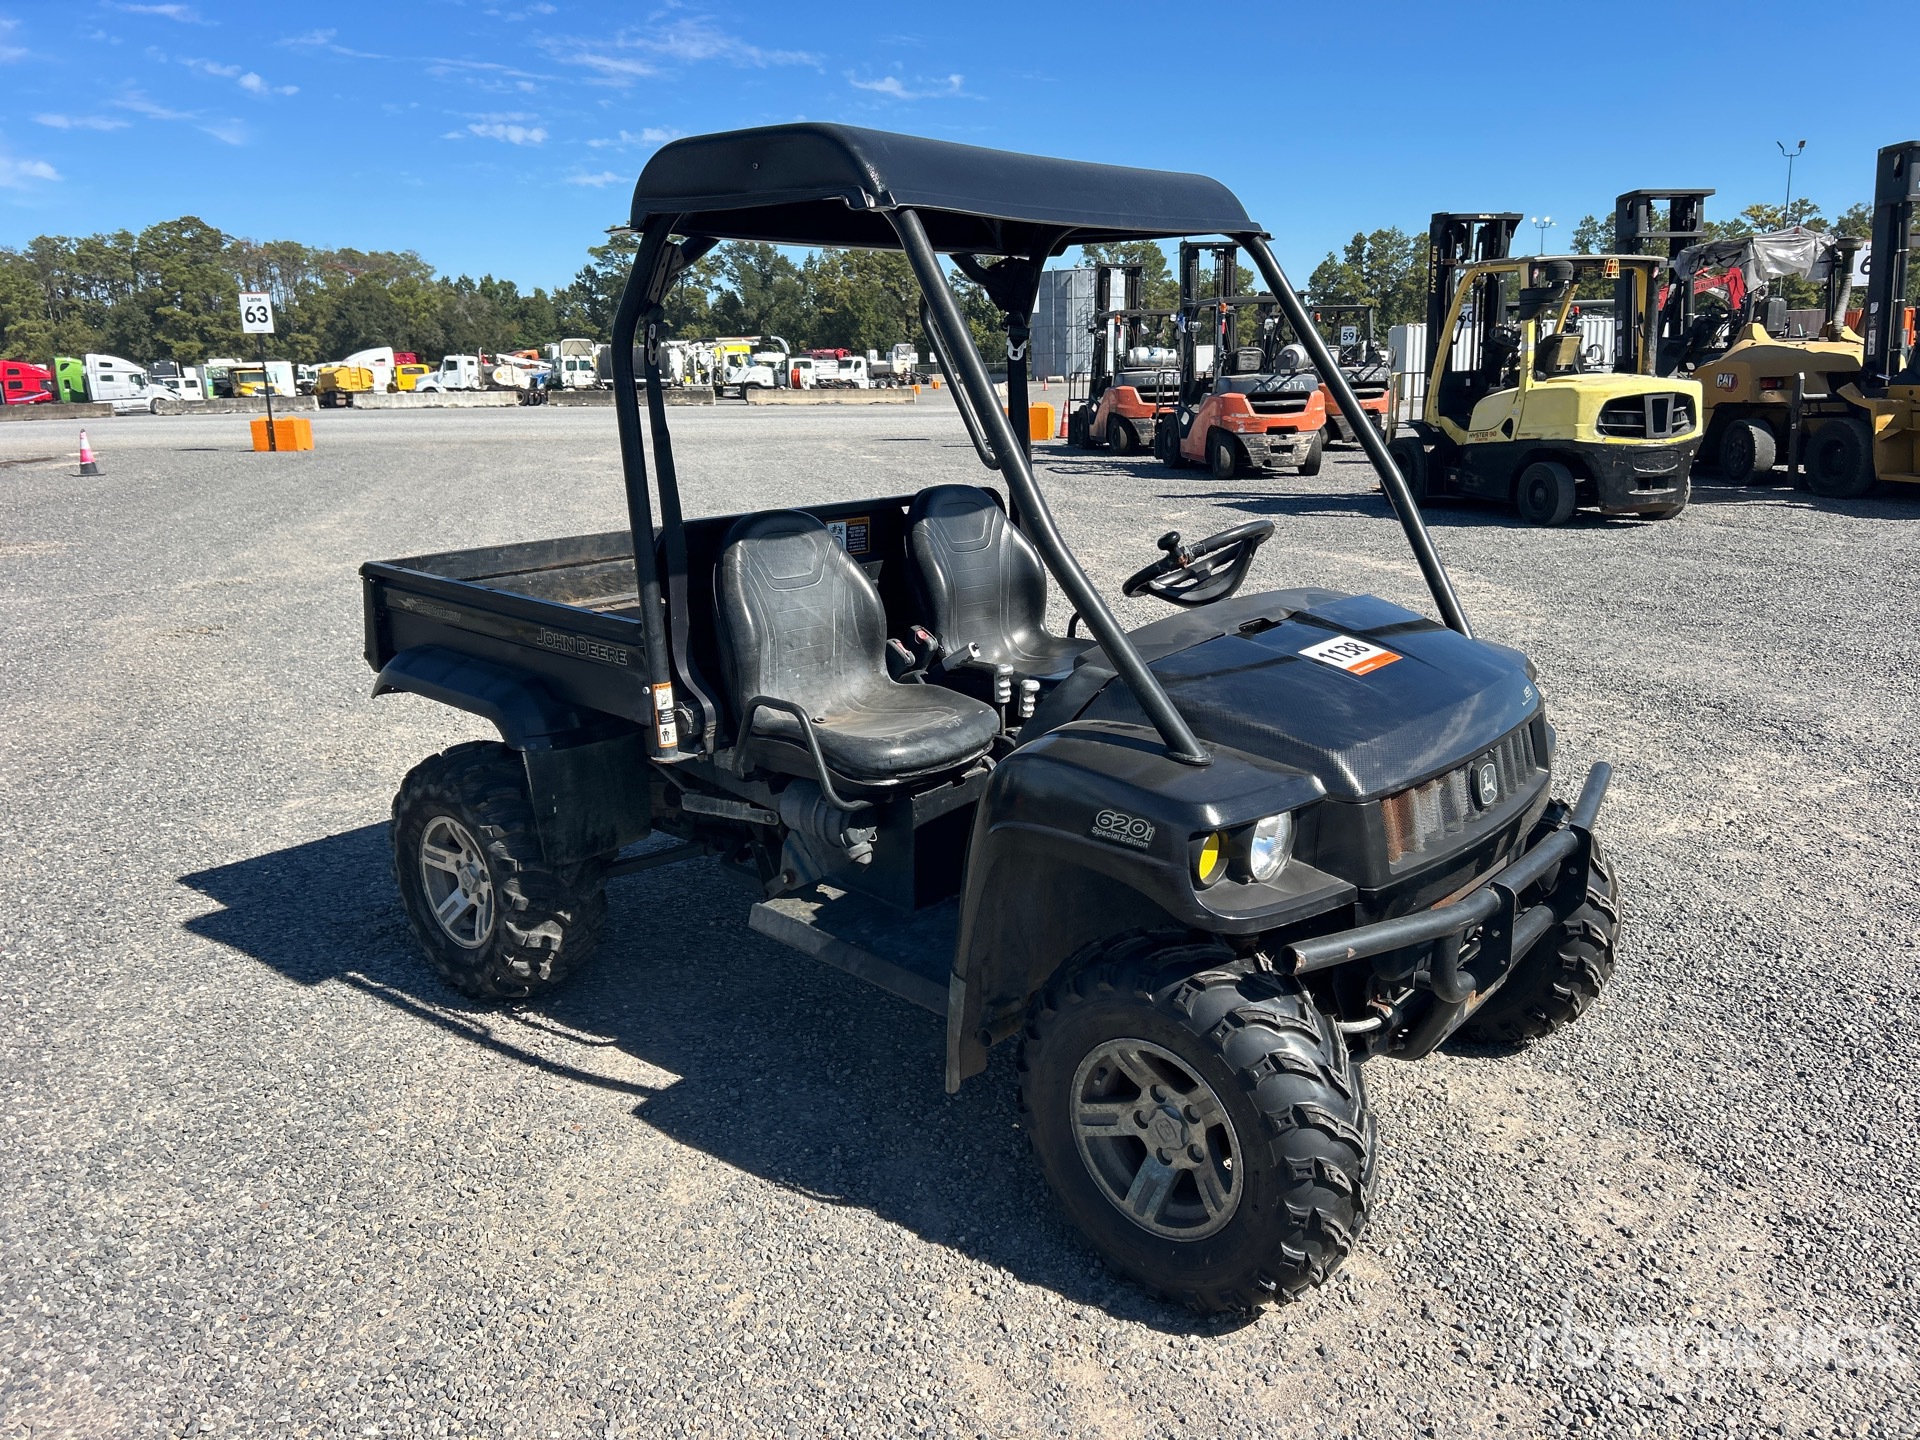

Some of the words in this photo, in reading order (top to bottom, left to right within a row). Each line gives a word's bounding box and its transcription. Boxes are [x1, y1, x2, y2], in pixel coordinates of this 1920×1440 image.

[1430, 245, 1438, 293] HYSTER
[245, 305, 269, 323] 63
[1342, 332, 1355, 341] 59
[1142, 376, 1181, 385] TOYO
[1716, 373, 1735, 388] CAT
[536, 627, 575, 653] JOHN
[576, 635, 628, 666] DEERE
[1318, 642, 1371, 662] 1138
[1095, 809, 1155, 841] 620i
[1091, 826, 1121, 840] Special
[1120, 835, 1149, 848] Edition
